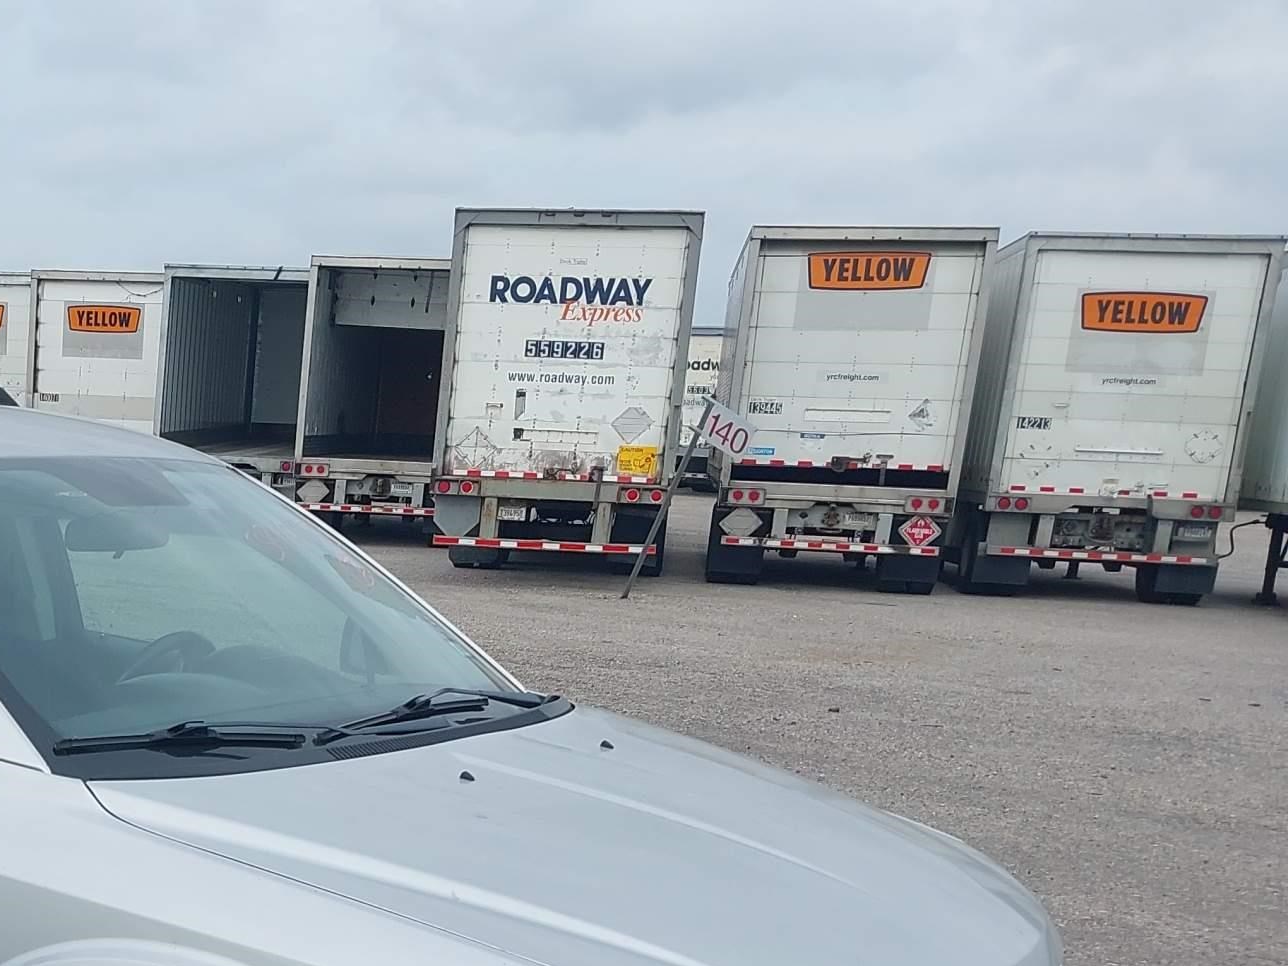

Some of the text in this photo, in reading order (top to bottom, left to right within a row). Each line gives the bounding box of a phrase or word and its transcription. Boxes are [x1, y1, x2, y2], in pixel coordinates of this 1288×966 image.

[822, 257, 915, 282] YELLOW
[489, 275, 654, 306] ROADWAY
[77, 310, 131, 328] YELLOW
[559, 301, 644, 327] Express
[1096, 299, 1192, 325] YELLOW
[526, 340, 603, 359] 559226
[508, 371, 615, 386] www.roadway.com
[826, 373, 879, 383] yrcfreight.com
[1102, 377, 1157, 386] yrcfreight.com
[749, 401, 783, 414] 139445
[708, 413, 749, 454] 140
